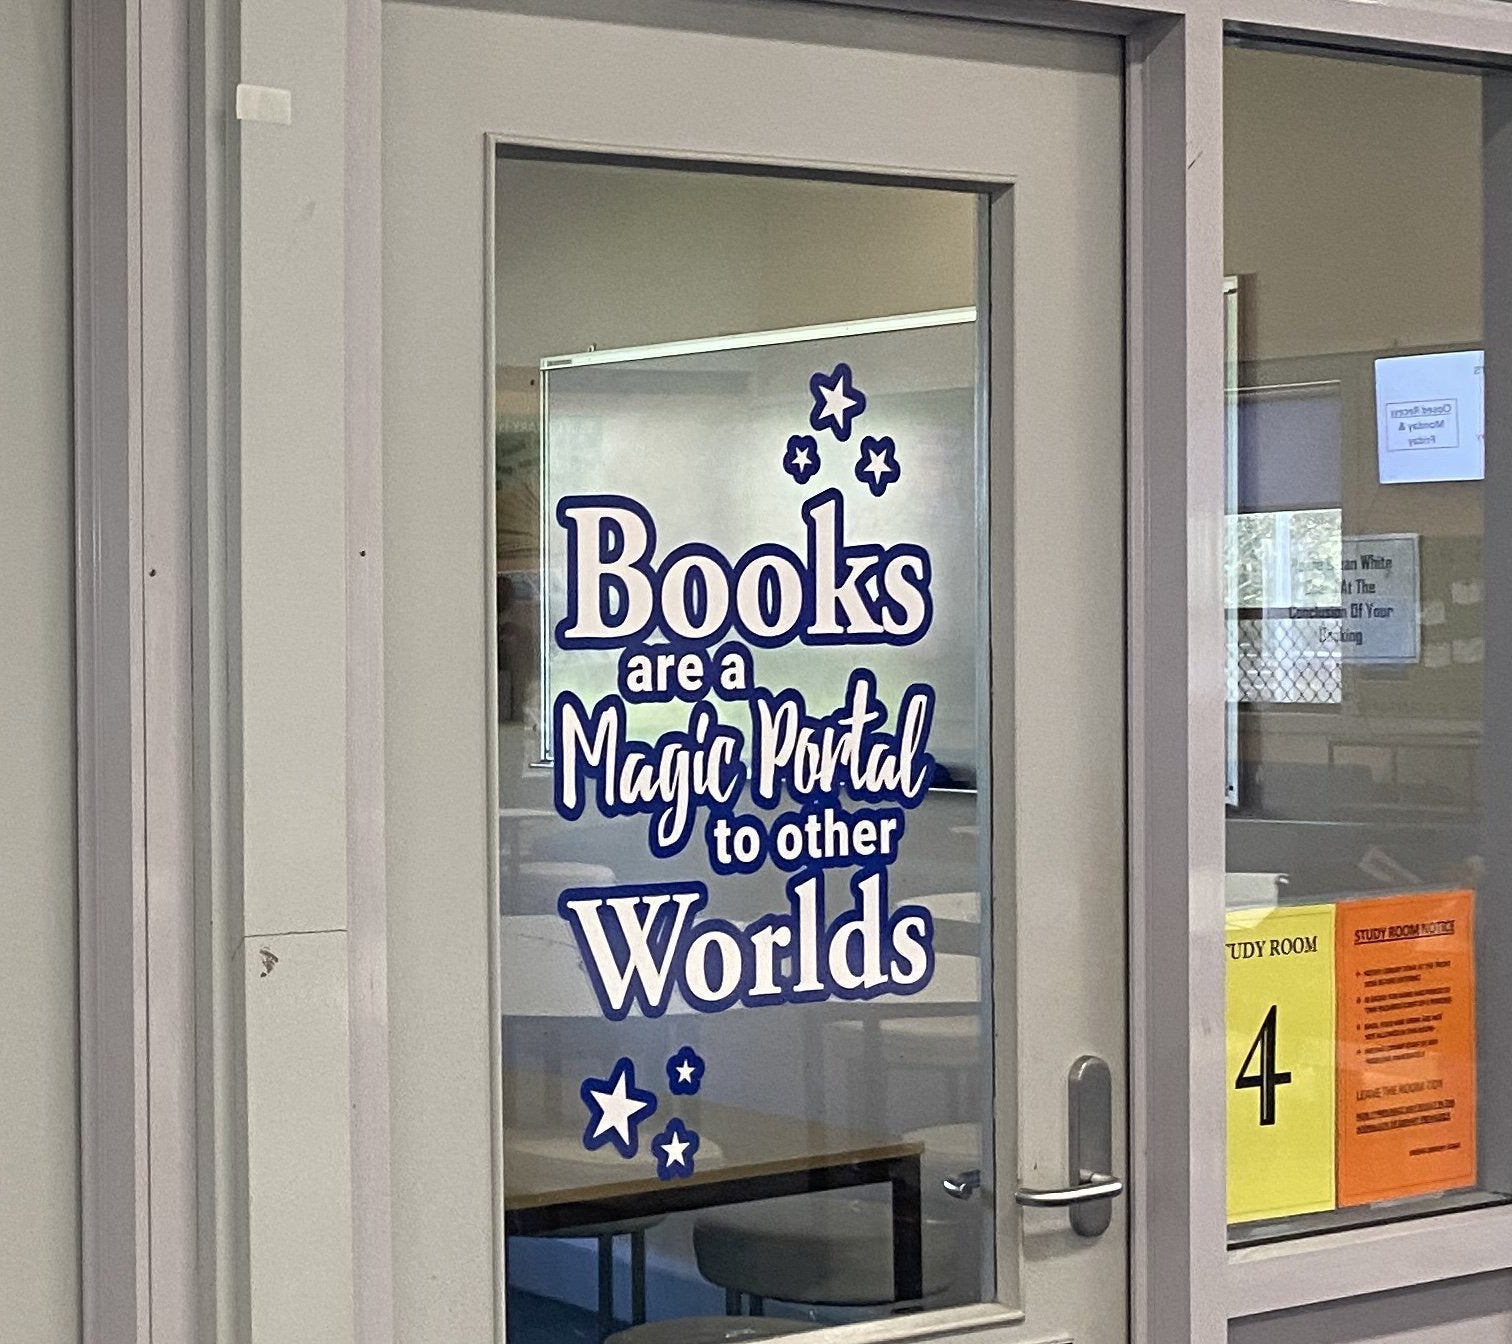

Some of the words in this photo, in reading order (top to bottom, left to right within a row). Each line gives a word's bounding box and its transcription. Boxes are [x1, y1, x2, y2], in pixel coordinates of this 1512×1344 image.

[559, 494, 931, 643] Books
[1356, 579, 1376, 594] The
[1351, 603, 1363, 619] Of
[1365, 602, 1393, 619] Your
[624, 649, 706, 694] are
[718, 650, 747, 692] a
[559, 700, 741, 850] Magic
[755, 677, 930, 802] Portal
[712, 817, 762, 865] to
[774, 806, 899, 860] other
[563, 870, 932, 1016] Worlds
[1270, 935, 1318, 957] ROOM
[1354, 927, 1386, 942] STUDY
[1388, 923, 1419, 938] ROOM
[1234, 1004, 1292, 1126] 4
